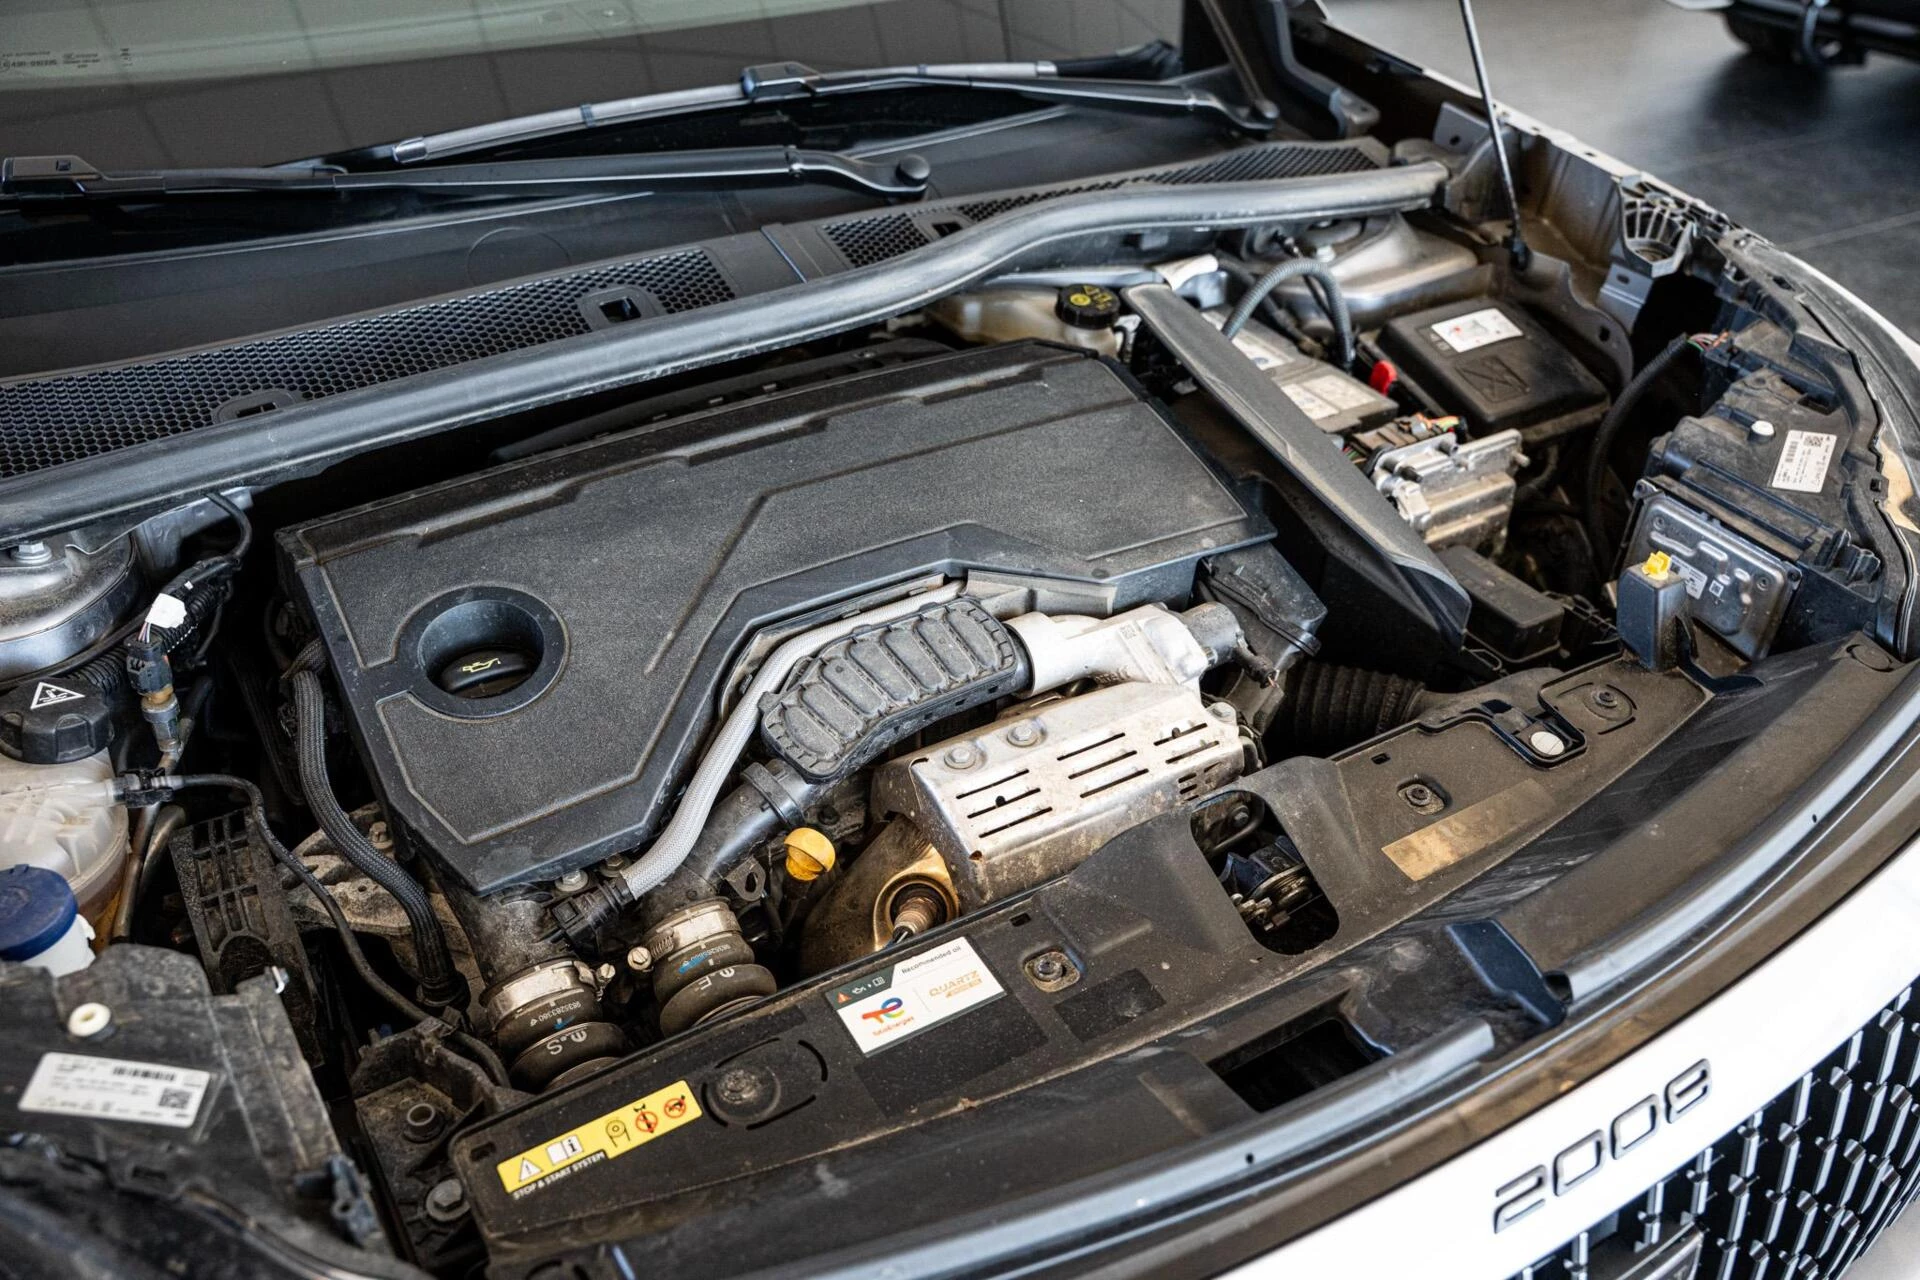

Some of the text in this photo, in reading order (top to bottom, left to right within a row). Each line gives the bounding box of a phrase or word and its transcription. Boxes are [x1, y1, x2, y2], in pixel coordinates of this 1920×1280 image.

[928, 970, 980, 997] QUARTZ
[1493, 1058, 1712, 1234] 2008
[513, 1182, 536, 1200] STOP
[546, 1165, 572, 1185] START
[573, 1151, 605, 1172] SYSTEM
